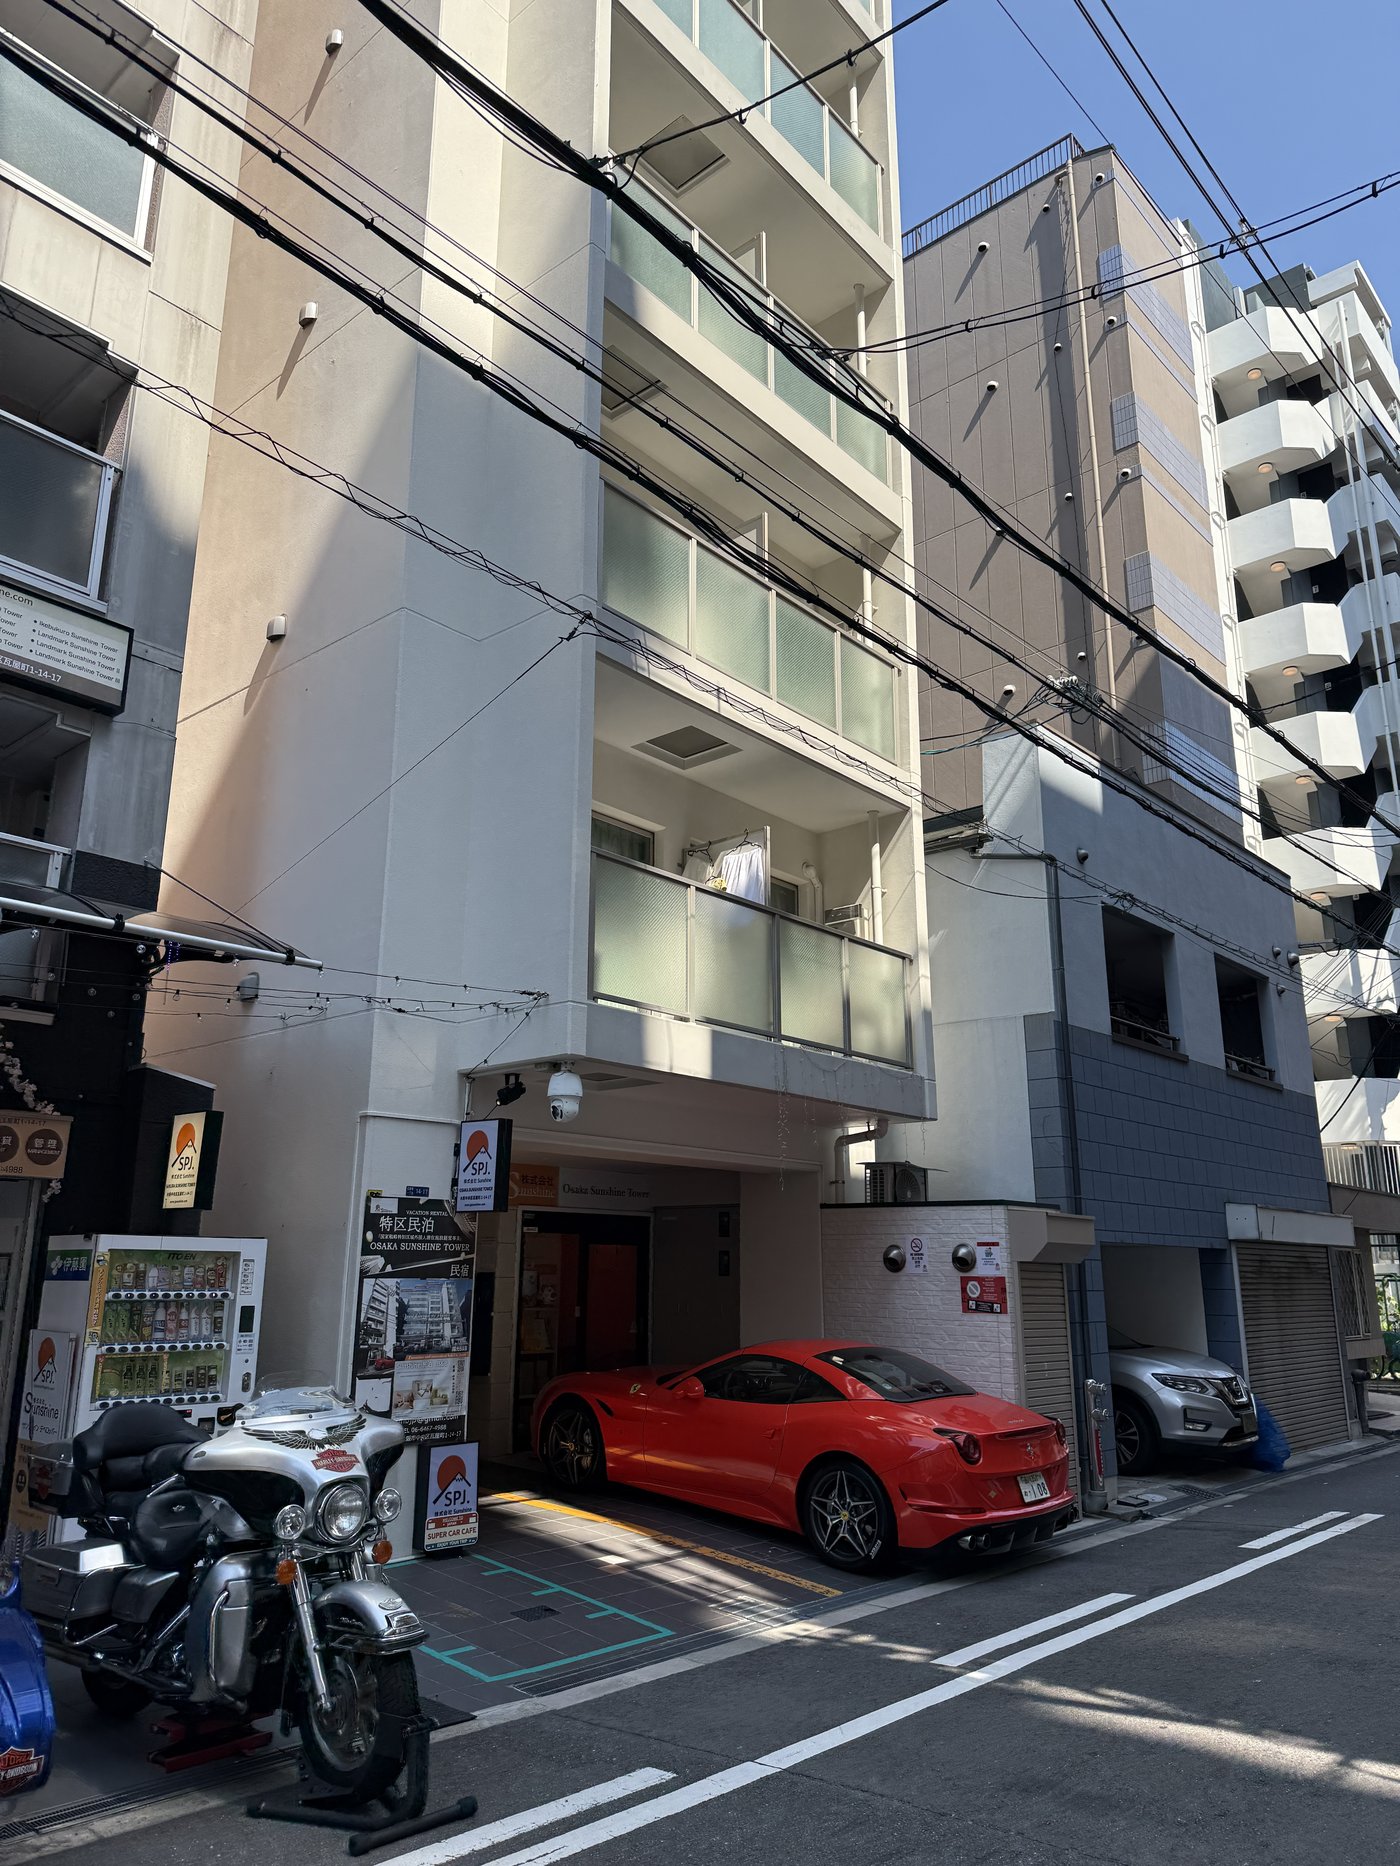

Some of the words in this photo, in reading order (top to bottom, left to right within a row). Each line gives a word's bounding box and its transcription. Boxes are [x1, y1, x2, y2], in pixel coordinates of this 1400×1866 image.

[37, 629, 69, 646] Landmark
[69, 641, 98, 656] Sunshine
[98, 651, 116, 662] Tower
[39, 620, 70, 636] Ikebukuro
[71, 631, 98, 646] Sunshine
[100, 642, 119, 653] Tower
[36, 639, 67, 655] Landmark
[68, 651, 96, 666] Sunshine
[97, 661, 115, 671] Tower
[35, 649, 66, 665] Landmark
[67, 660, 95, 675] Sunshine
[96, 670, 114, 682] Tower
[562, 1184, 589, 1194] Osaka
[590, 1186, 626, 1197] Sunshine
[627, 1188, 650, 1198] Tower
[379, 1215, 434, 1233] 特区民泊
[370, 1242, 398, 1251] OSAKA
[400, 1242, 442, 1251] SUNSHINE
[443, 1243, 470, 1252] TOWER
[450, 1264, 470, 1277] 民宿
[427, 1531, 448, 1540] SUPER
[448, 1529, 461, 1537] CAR
[461, 1526, 477, 1535] CAFE
